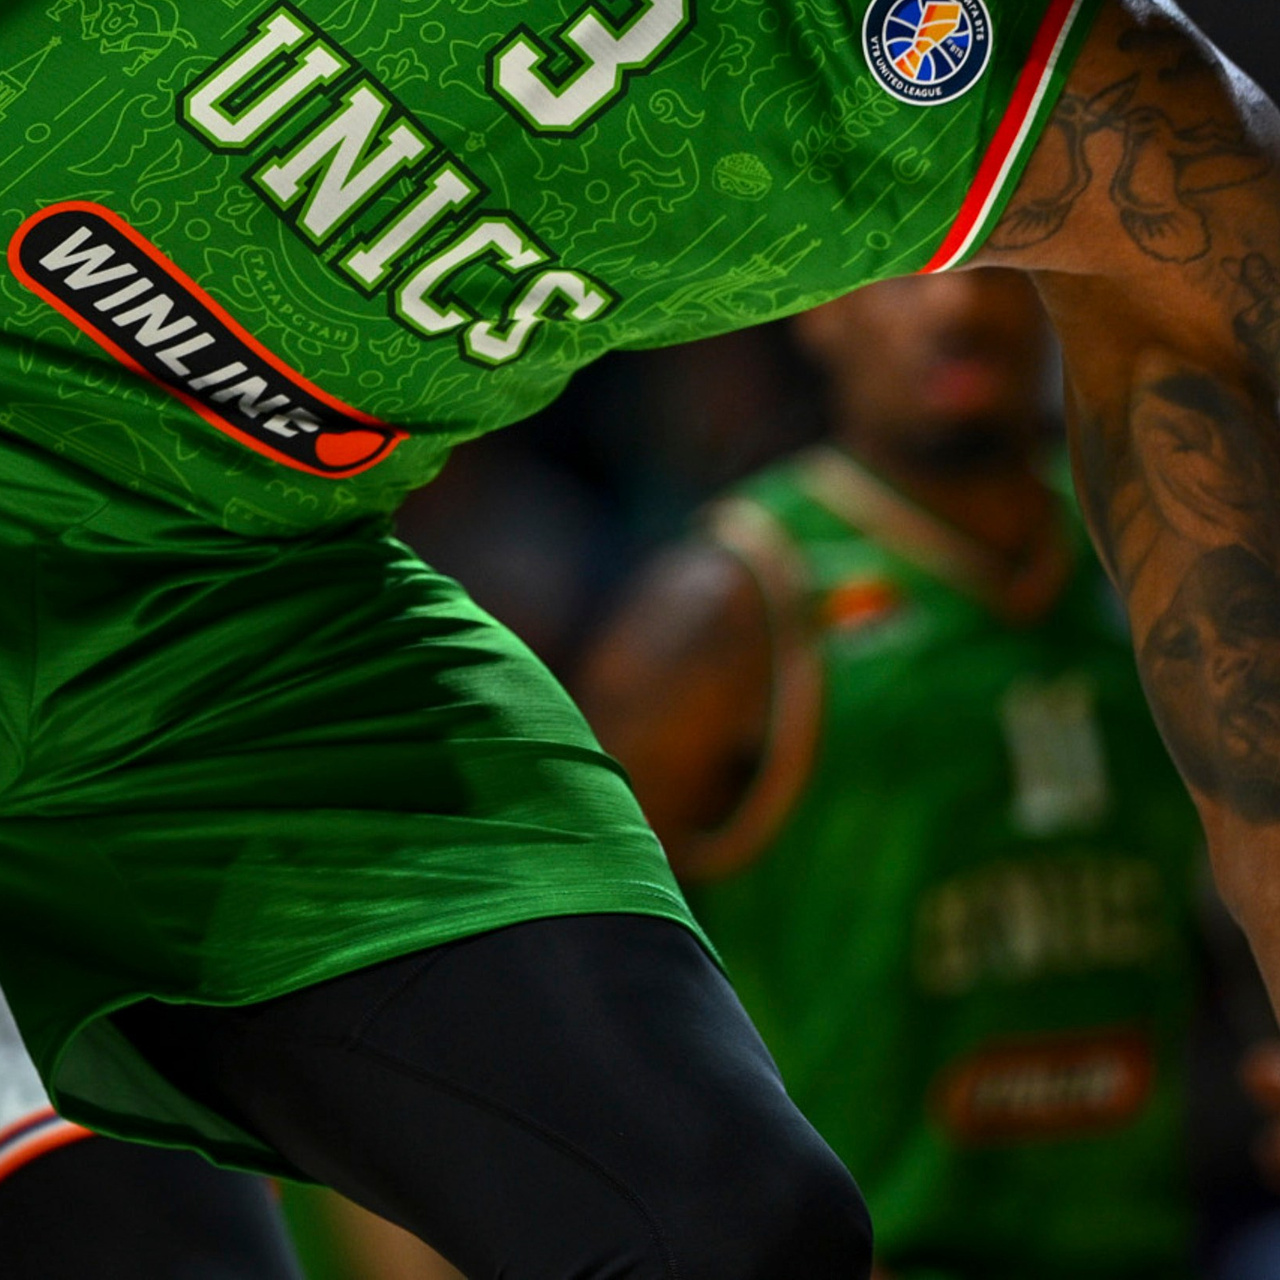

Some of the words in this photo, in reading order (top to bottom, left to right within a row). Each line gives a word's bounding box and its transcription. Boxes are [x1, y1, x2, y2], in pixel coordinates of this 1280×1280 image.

[876, 57, 904, 90] UNITED
[903, 84, 943, 98] LEAGUE
[973, 19, 985, 41] ВТБ
[178, 0, 617, 368] UNICS
[38, 225, 320, 438] WINLINE
